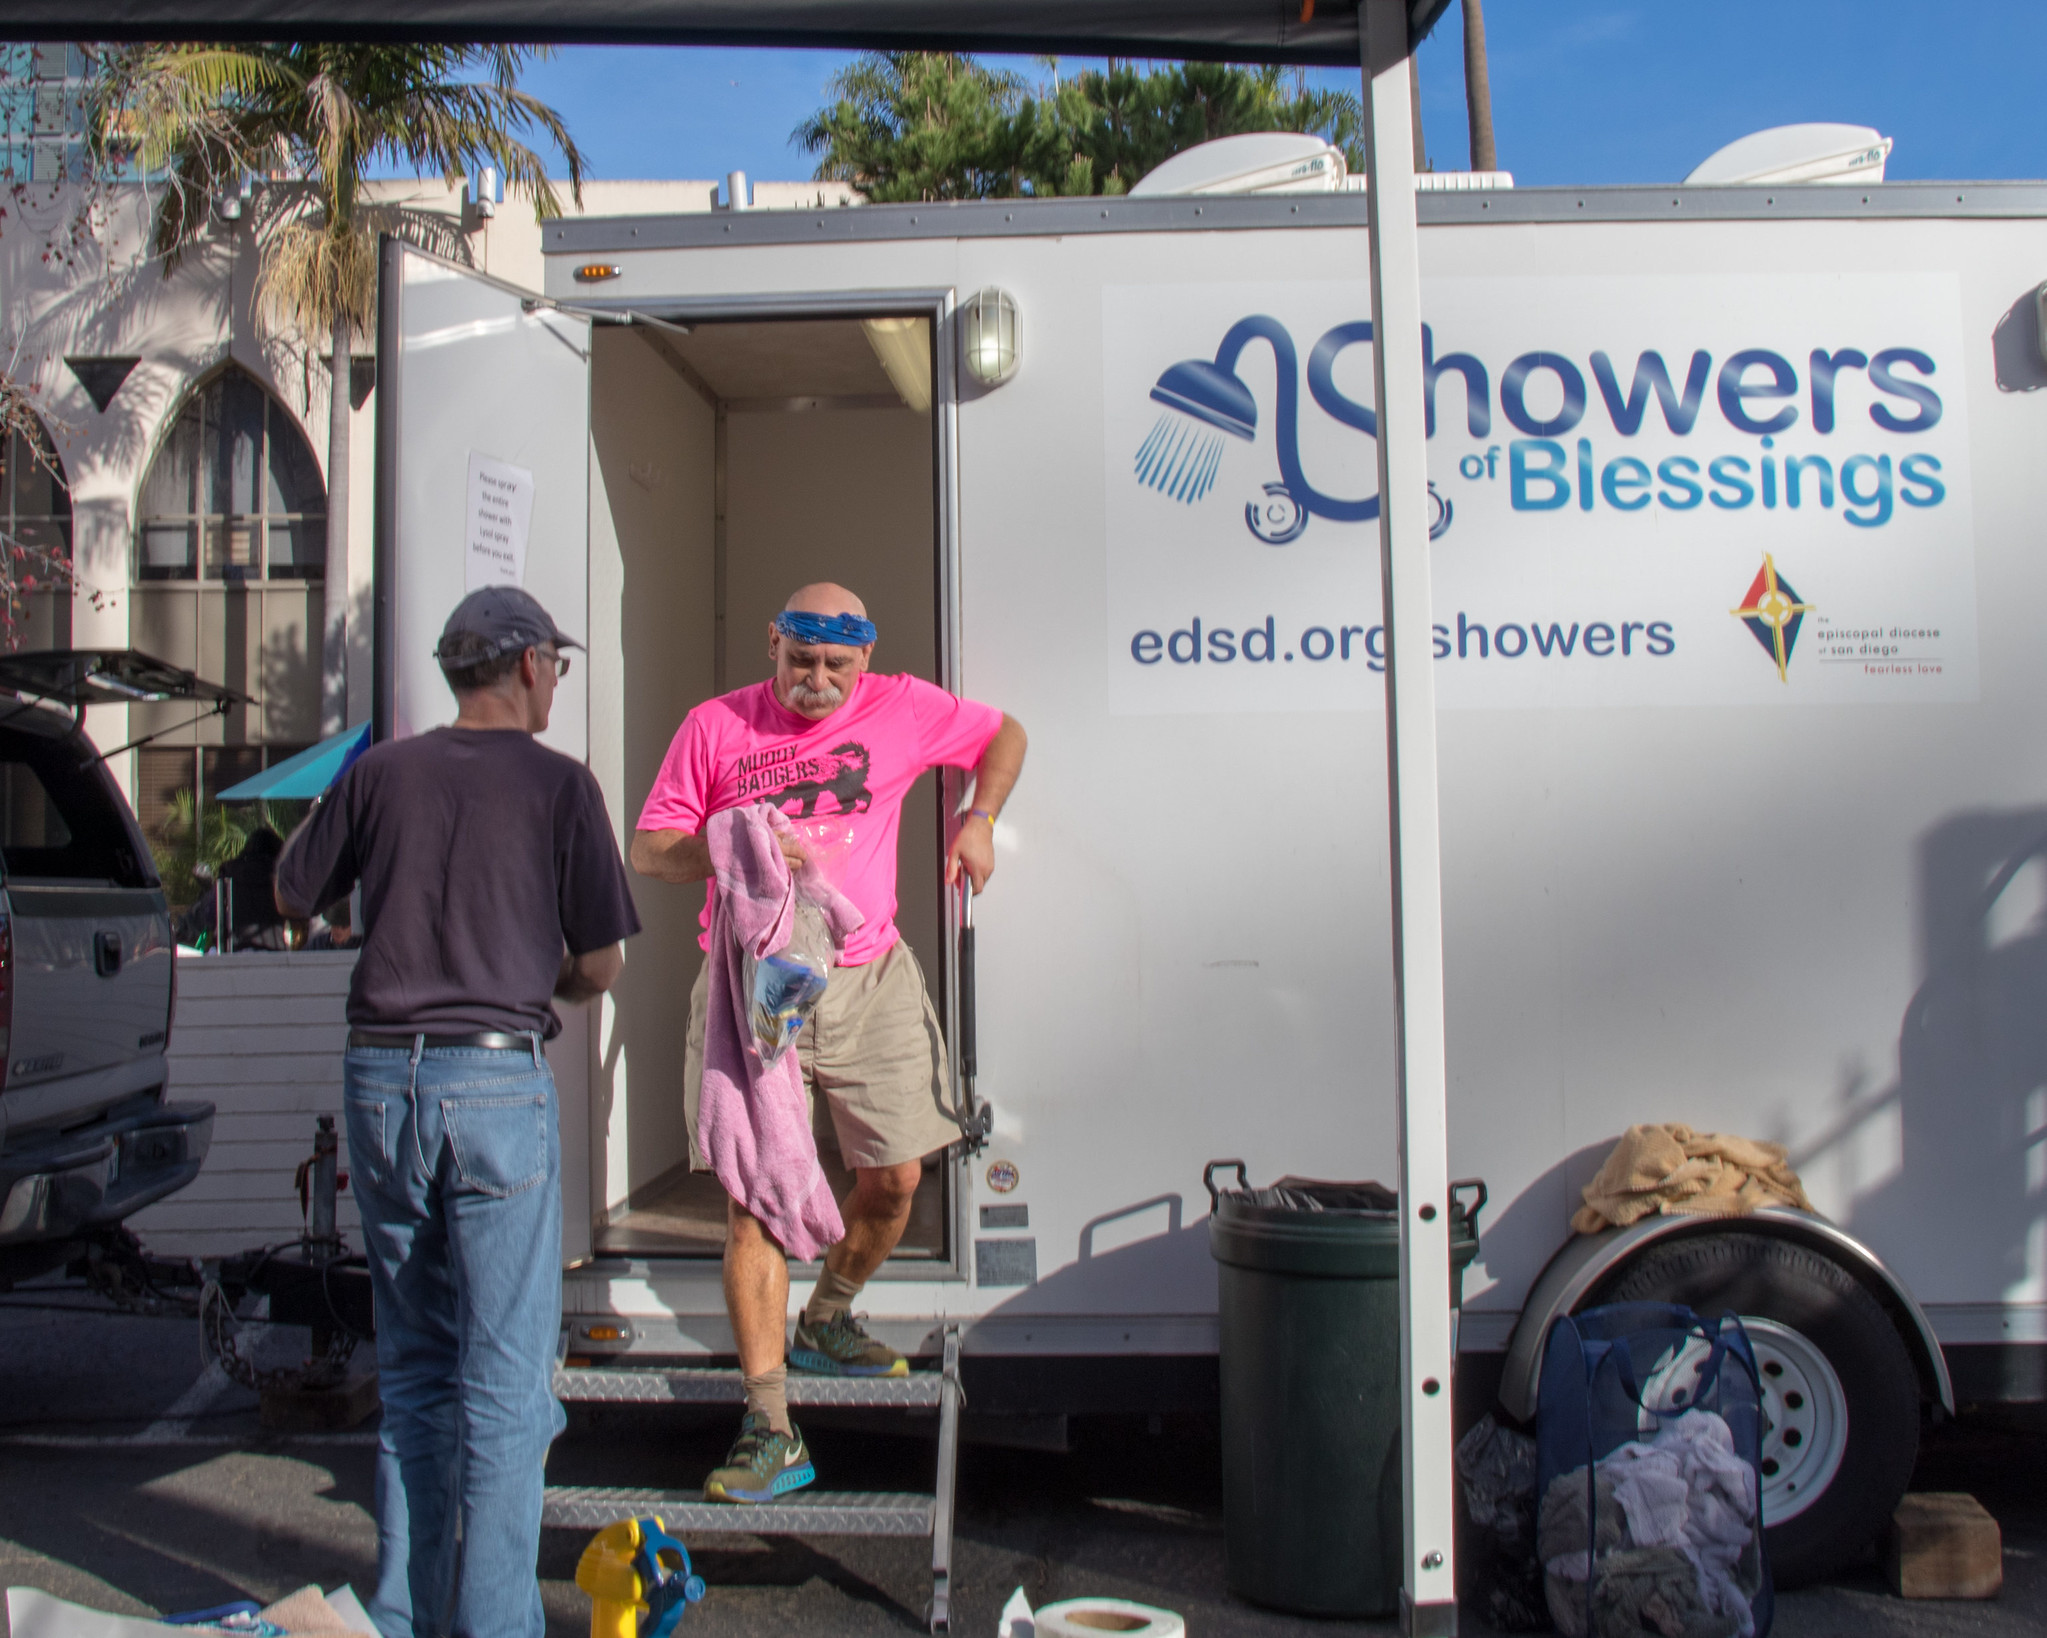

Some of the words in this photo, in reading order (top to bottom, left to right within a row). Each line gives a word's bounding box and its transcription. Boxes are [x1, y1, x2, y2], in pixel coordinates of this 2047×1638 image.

[1307, 320, 1943, 522] Showers
[498, 479, 517, 493] spray
[1459, 446, 1500, 480] of
[1509, 435, 1946, 528] Blessings
[499, 515, 512, 527] with
[494, 532, 510, 545] spray
[1817, 627, 1884, 641] episcopal
[1889, 626, 1940, 638] diocese
[1831, 646, 1853, 655] san
[1859, 643, 1898, 656] diego
[1864, 663, 1912, 674] fearless
[1917, 663, 1943, 674] love
[738, 744, 798, 778] MUDDY
[737, 758, 820, 799] BADGERS
